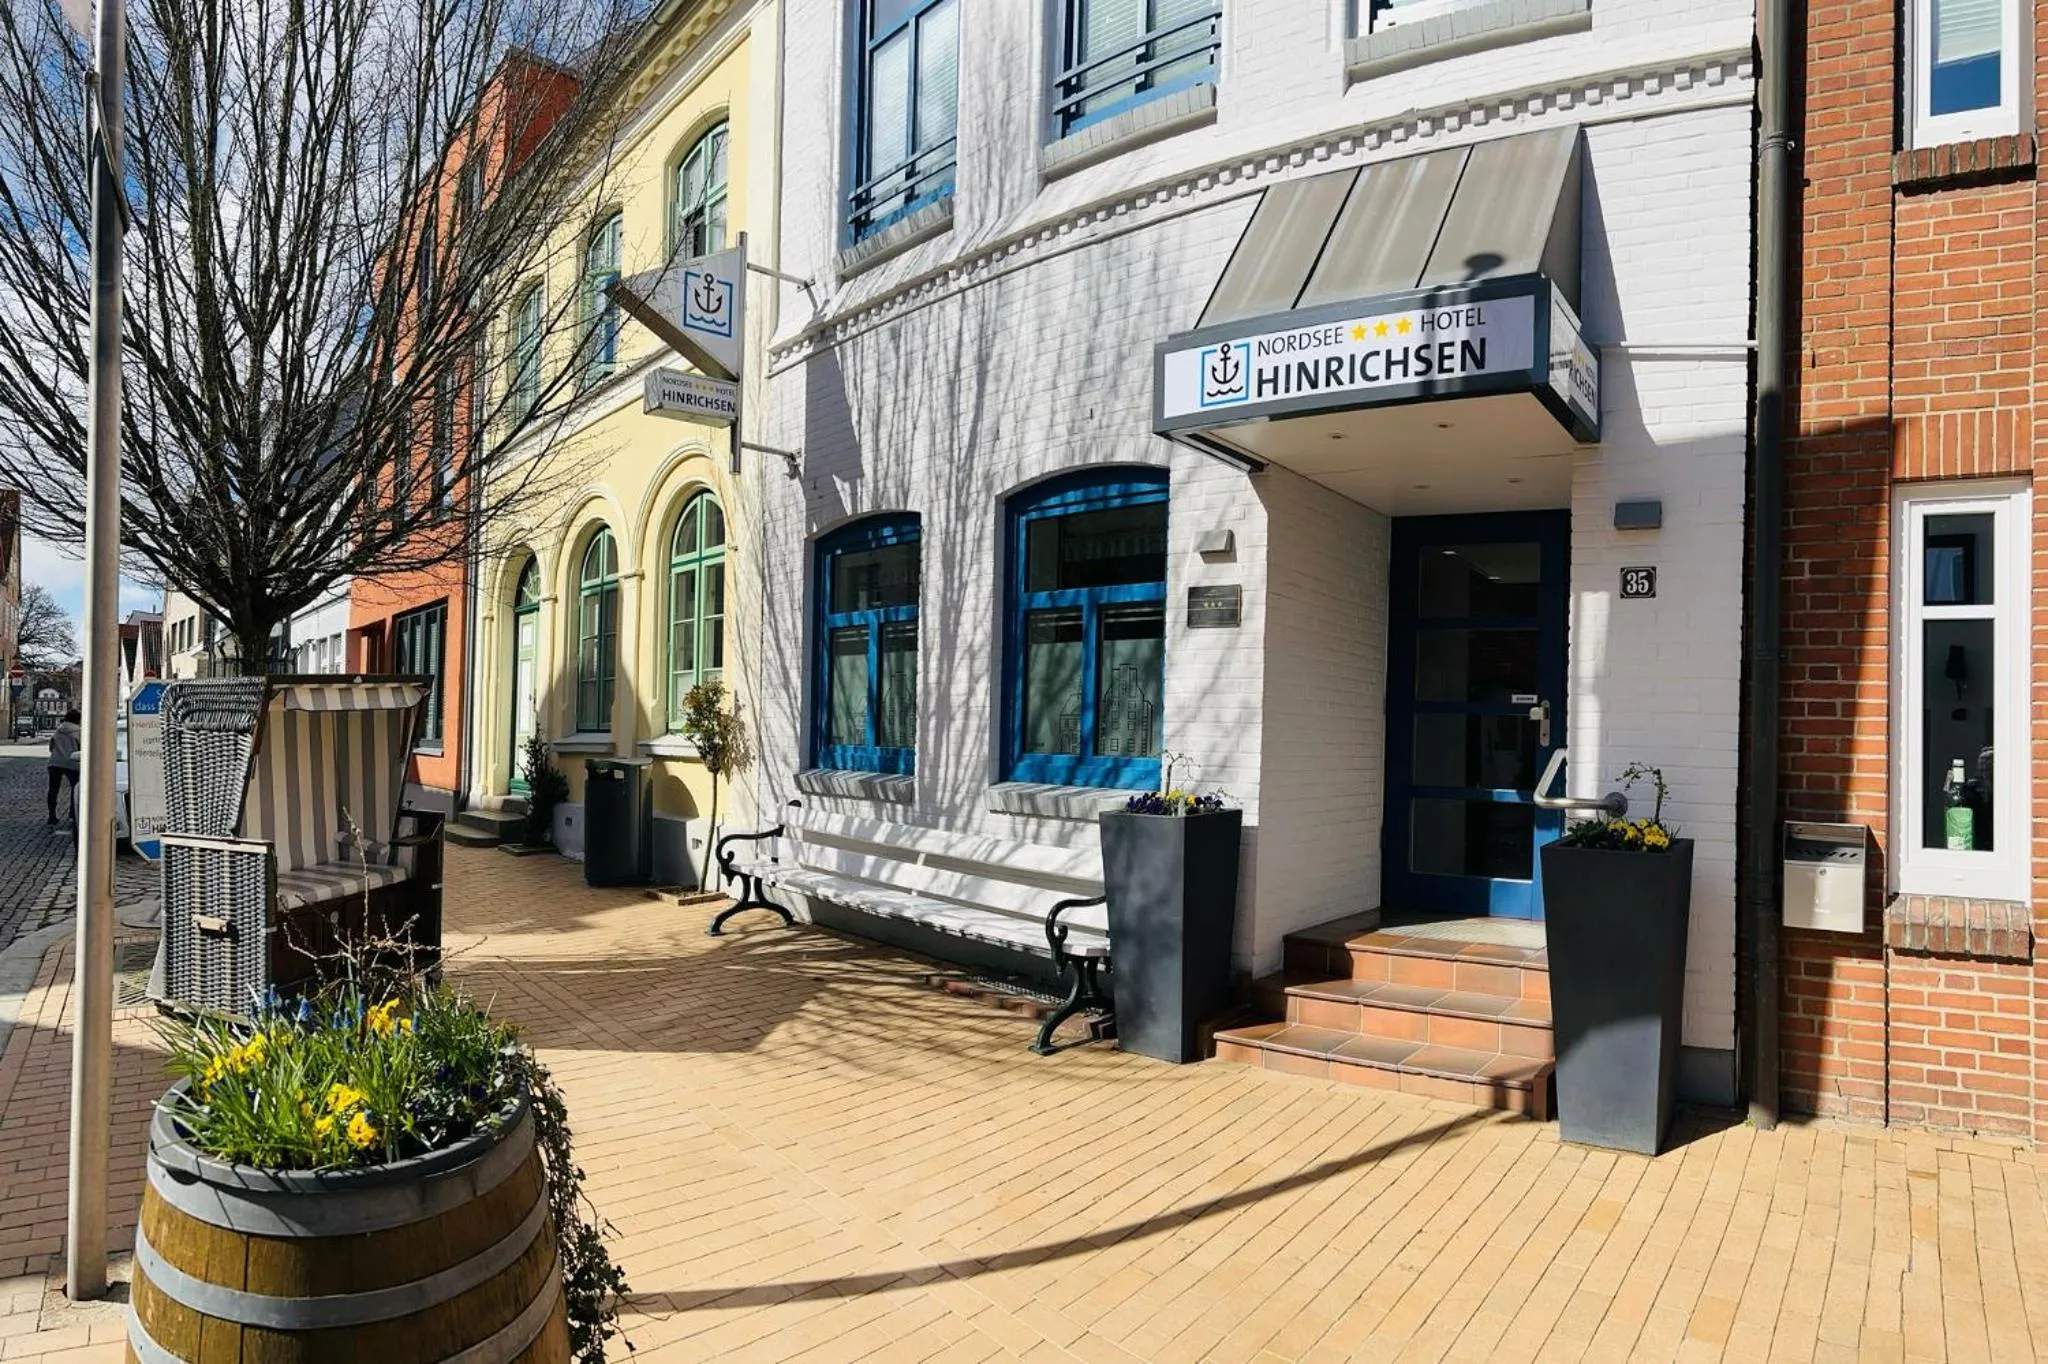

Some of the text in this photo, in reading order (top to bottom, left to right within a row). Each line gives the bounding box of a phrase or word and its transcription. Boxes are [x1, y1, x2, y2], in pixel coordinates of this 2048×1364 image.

[1257, 308, 1486, 357] NORDSEE HOTEL
[1257, 336, 1487, 398] HINRICHSEN
[662, 389, 736, 412] HINRICHSEN
[1626, 571, 1649, 594] 35
